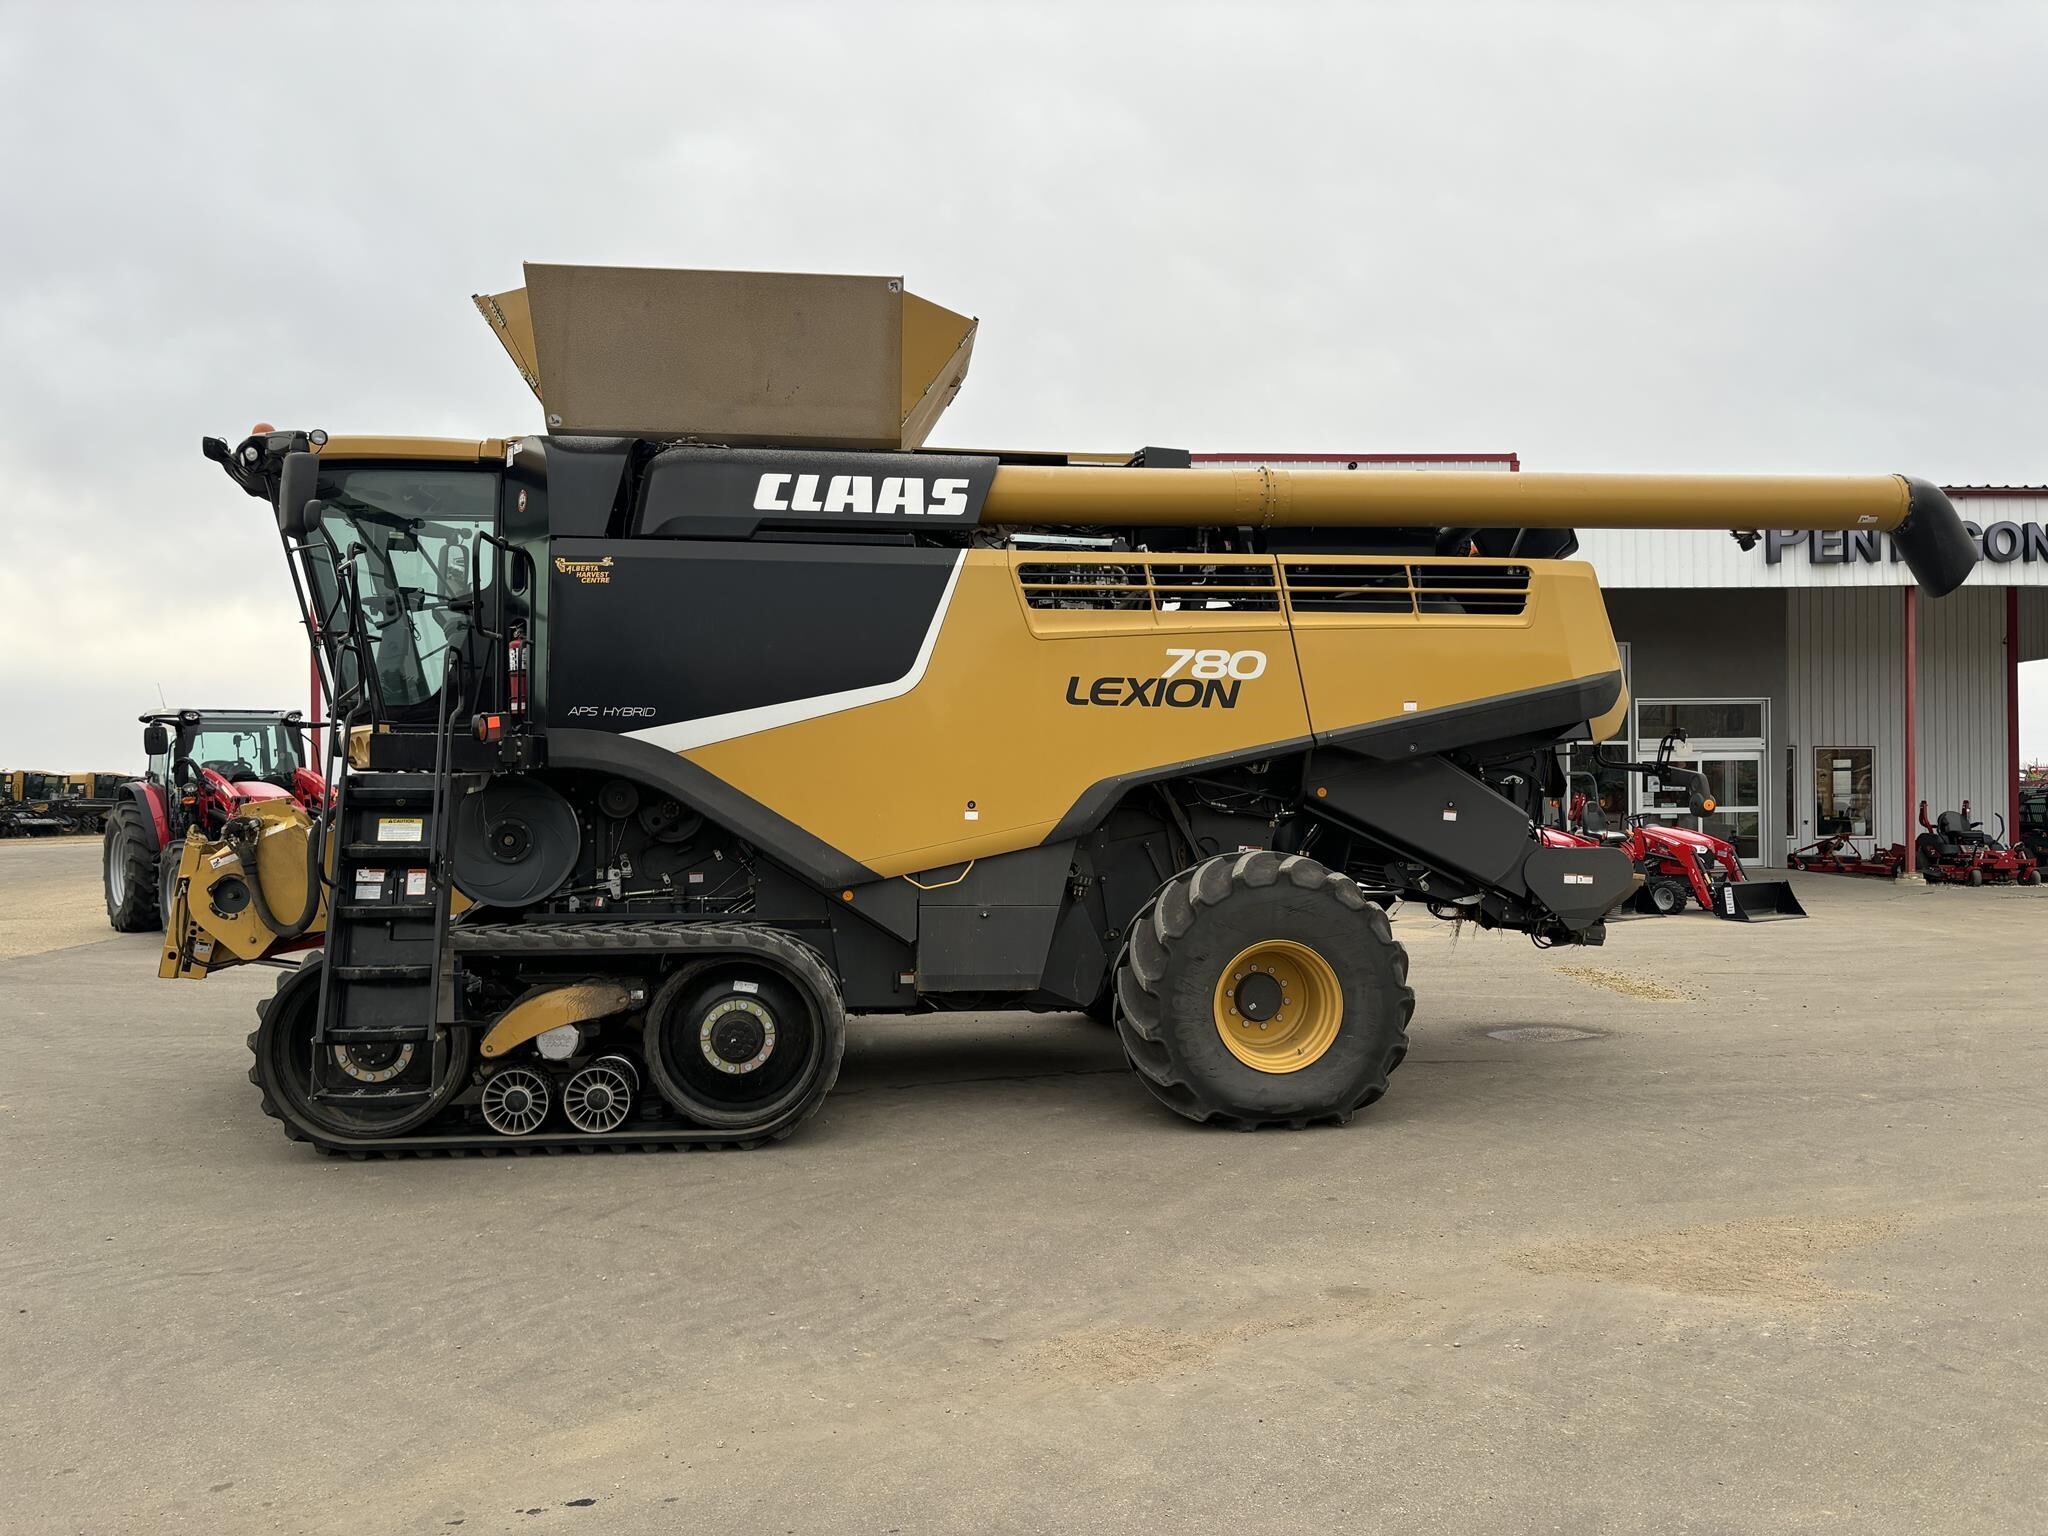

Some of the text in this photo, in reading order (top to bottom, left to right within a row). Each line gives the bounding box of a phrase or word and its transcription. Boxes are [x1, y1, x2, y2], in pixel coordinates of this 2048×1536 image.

[753, 473, 970, 516] CLAAS
[566, 566, 599, 574] ALBERTA
[1161, 648, 1267, 680] 780
[1066, 676, 1242, 709] LEXION
[567, 706, 657, 718] APS HYBRID
